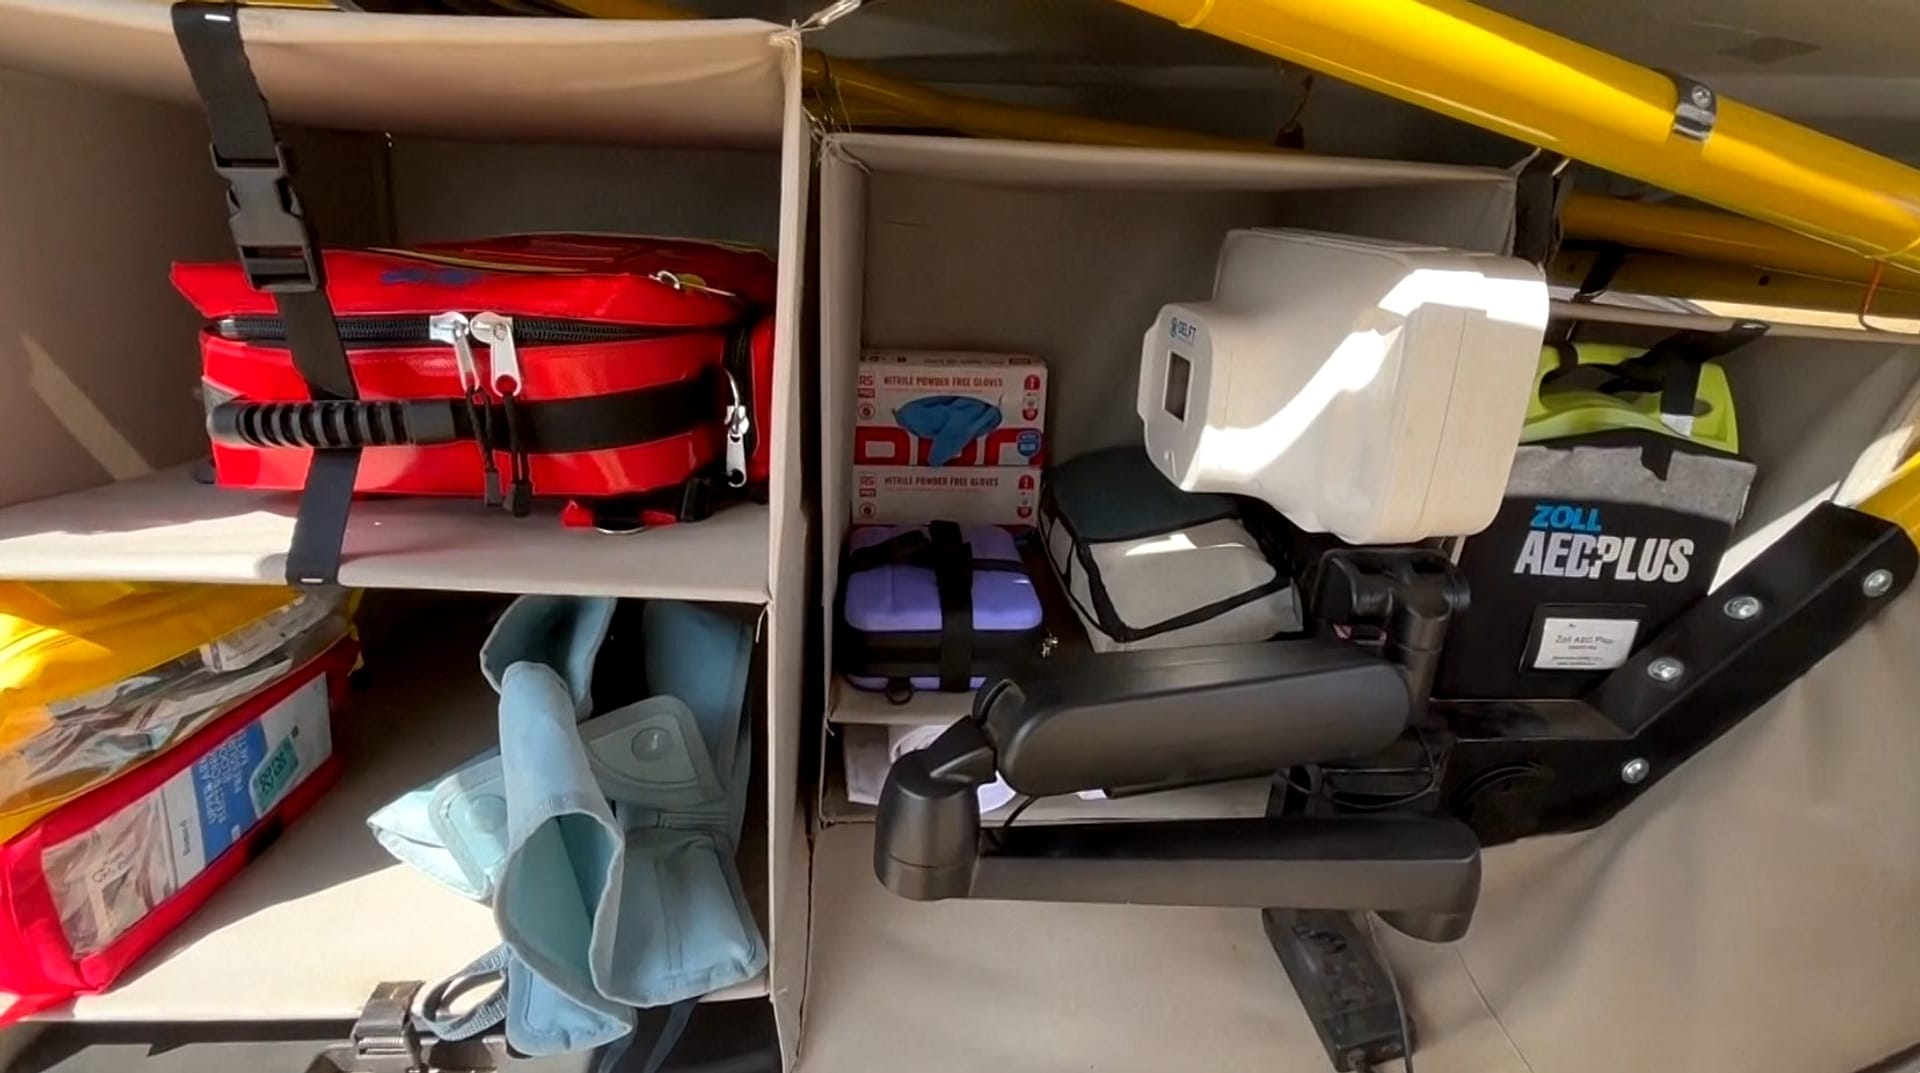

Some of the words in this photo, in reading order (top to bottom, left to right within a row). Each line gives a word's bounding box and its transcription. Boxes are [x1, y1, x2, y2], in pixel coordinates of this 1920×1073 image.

[884, 376, 912, 386] NITRILE
[916, 376, 949, 387] POWDER
[952, 377, 971, 387] FREE
[973, 377, 1003, 388] GLOVES
[884, 475, 912, 486] NITRILE
[915, 475, 948, 486] POWDER
[950, 476, 968, 487] FREE
[970, 476, 999, 487] GLOVES
[1530, 505, 1602, 531] ZOLL
